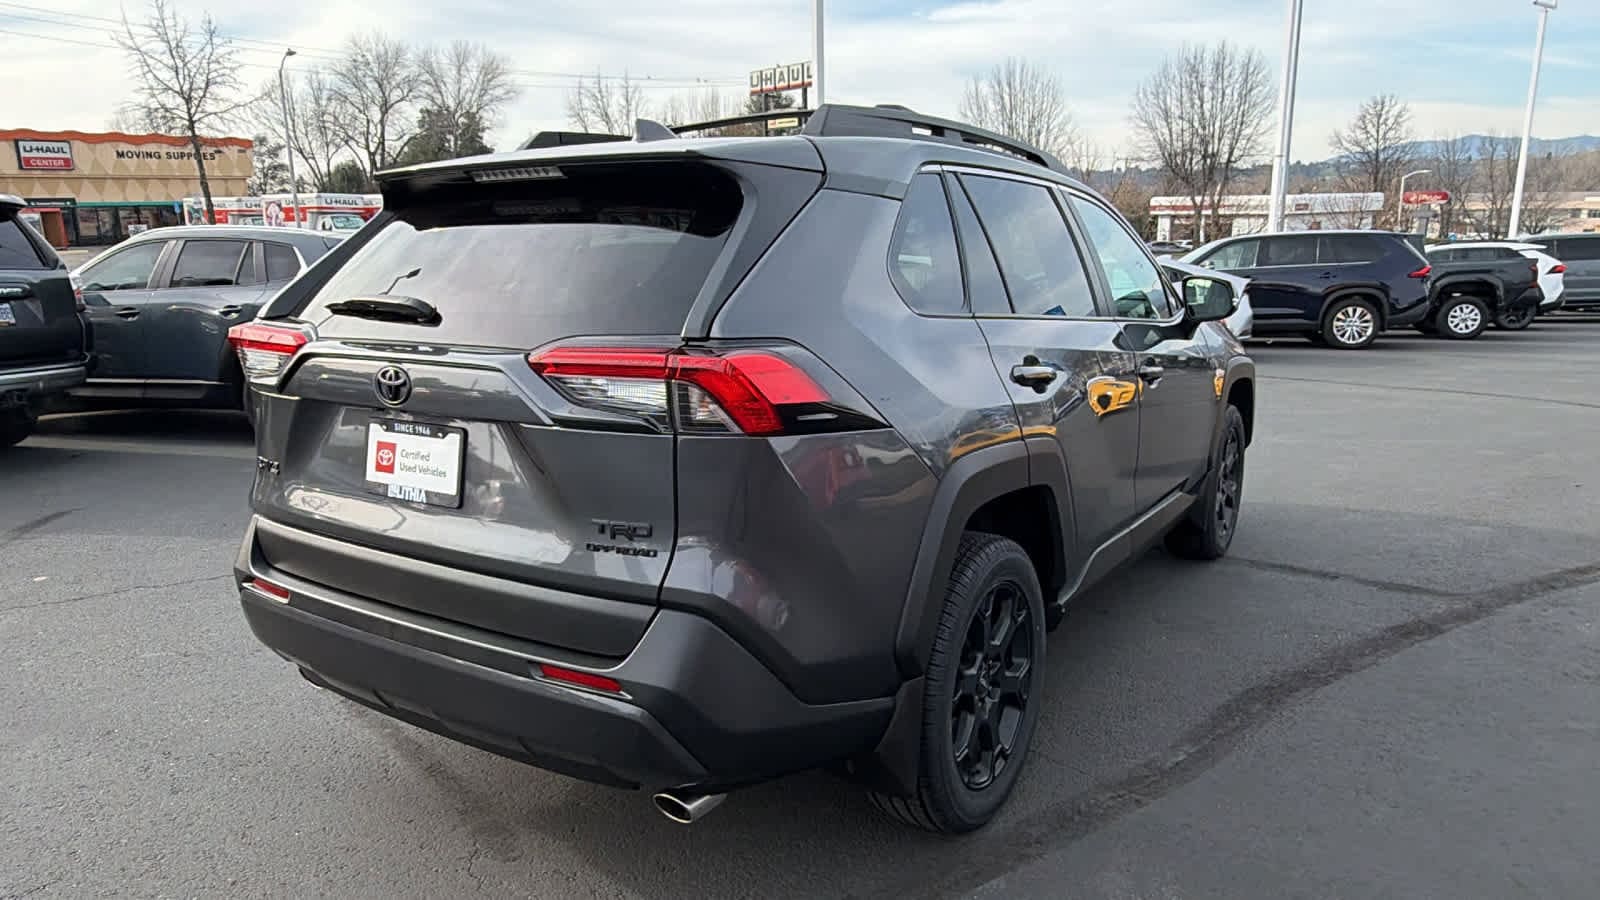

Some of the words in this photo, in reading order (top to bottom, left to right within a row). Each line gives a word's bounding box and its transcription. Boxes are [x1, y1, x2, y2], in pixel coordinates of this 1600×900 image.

[115, 150, 161, 160] MOVING
[165, 151, 216, 161] SUPPES
[30, 158, 65, 167] CENTER
[394, 423, 414, 433] SINCE
[400, 449, 431, 462] Certified
[399, 462, 417, 473] Used
[418, 465, 447, 478] Vehicles
[591, 518, 653, 541] TRD
